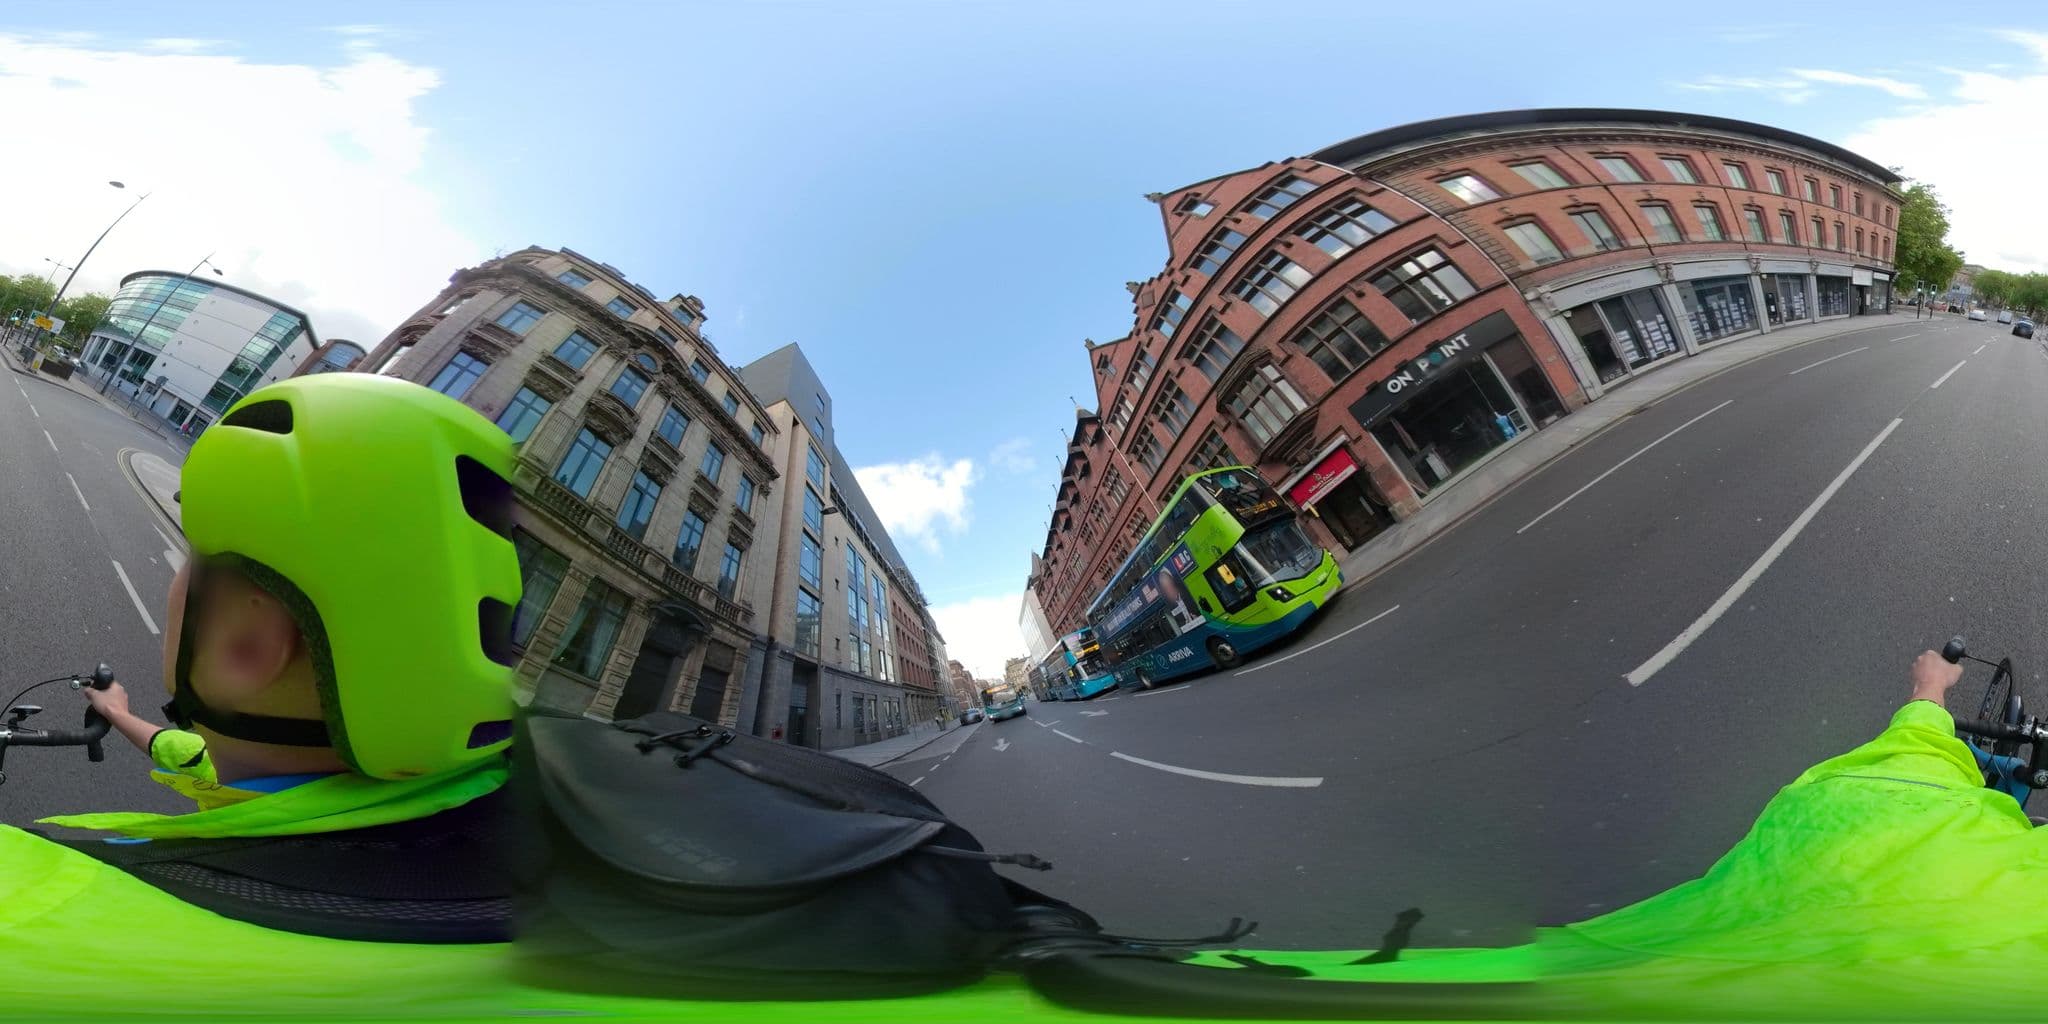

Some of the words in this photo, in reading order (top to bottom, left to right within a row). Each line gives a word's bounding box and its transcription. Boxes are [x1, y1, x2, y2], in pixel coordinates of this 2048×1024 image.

[1387, 370, 1415, 393] ON
[1416, 333, 1470, 373] POINT
[1173, 549, 1191, 570] LBC
[1168, 646, 1194, 663] ARRIVA
